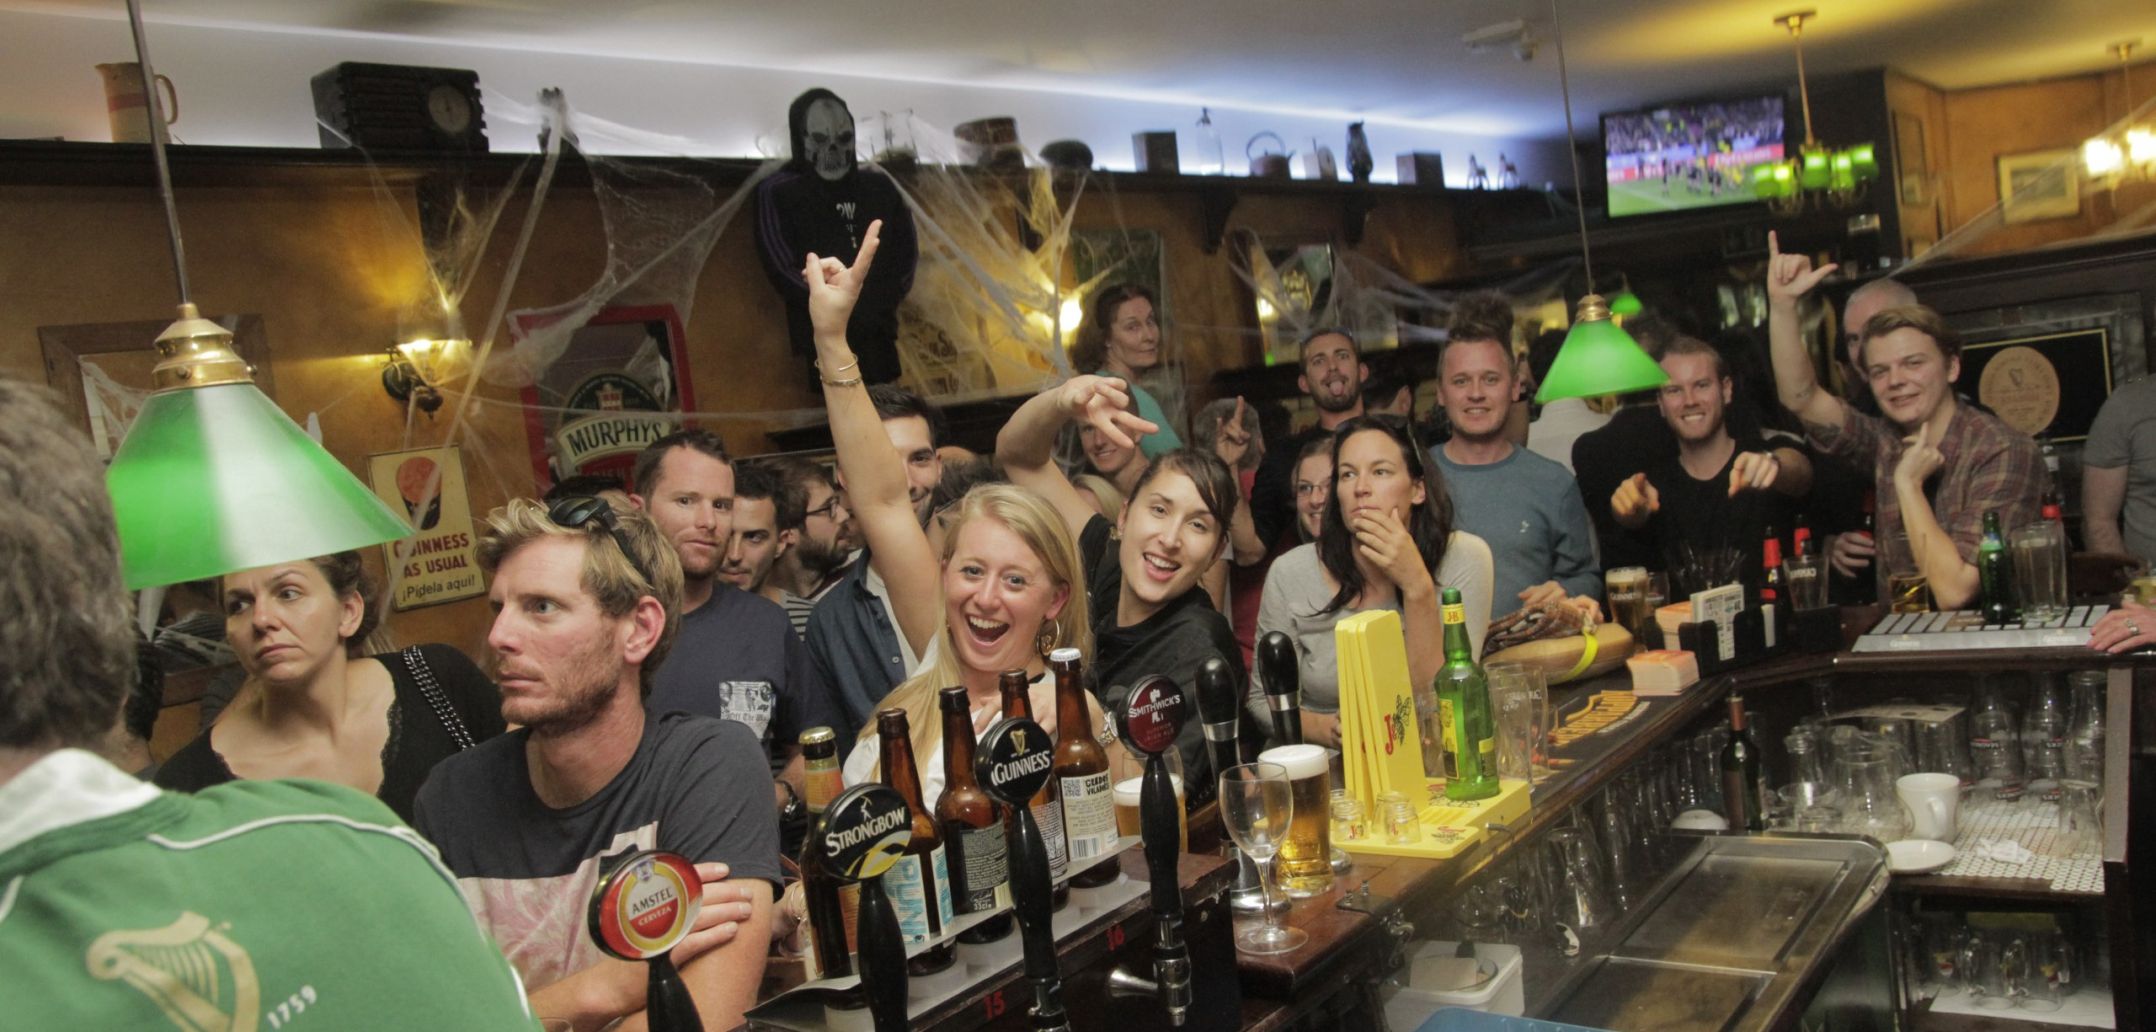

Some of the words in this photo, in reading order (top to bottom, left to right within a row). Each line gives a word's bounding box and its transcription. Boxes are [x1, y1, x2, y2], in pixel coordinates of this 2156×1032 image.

[404, 563, 421, 579] AS
[426, 555, 468, 573] USUAL
[1128, 694, 1181, 718] SMITHWICK'S
[993, 750, 1051, 785] GUINNESS
[825, 806, 906, 857] STRONGBOW
[632, 887, 674, 915] AMSTEL
[638, 906, 672, 926] CERVEZA
[1107, 924, 1125, 951] 16
[267, 984, 317, 1029] 1759
[984, 991, 1005, 1020] 15
